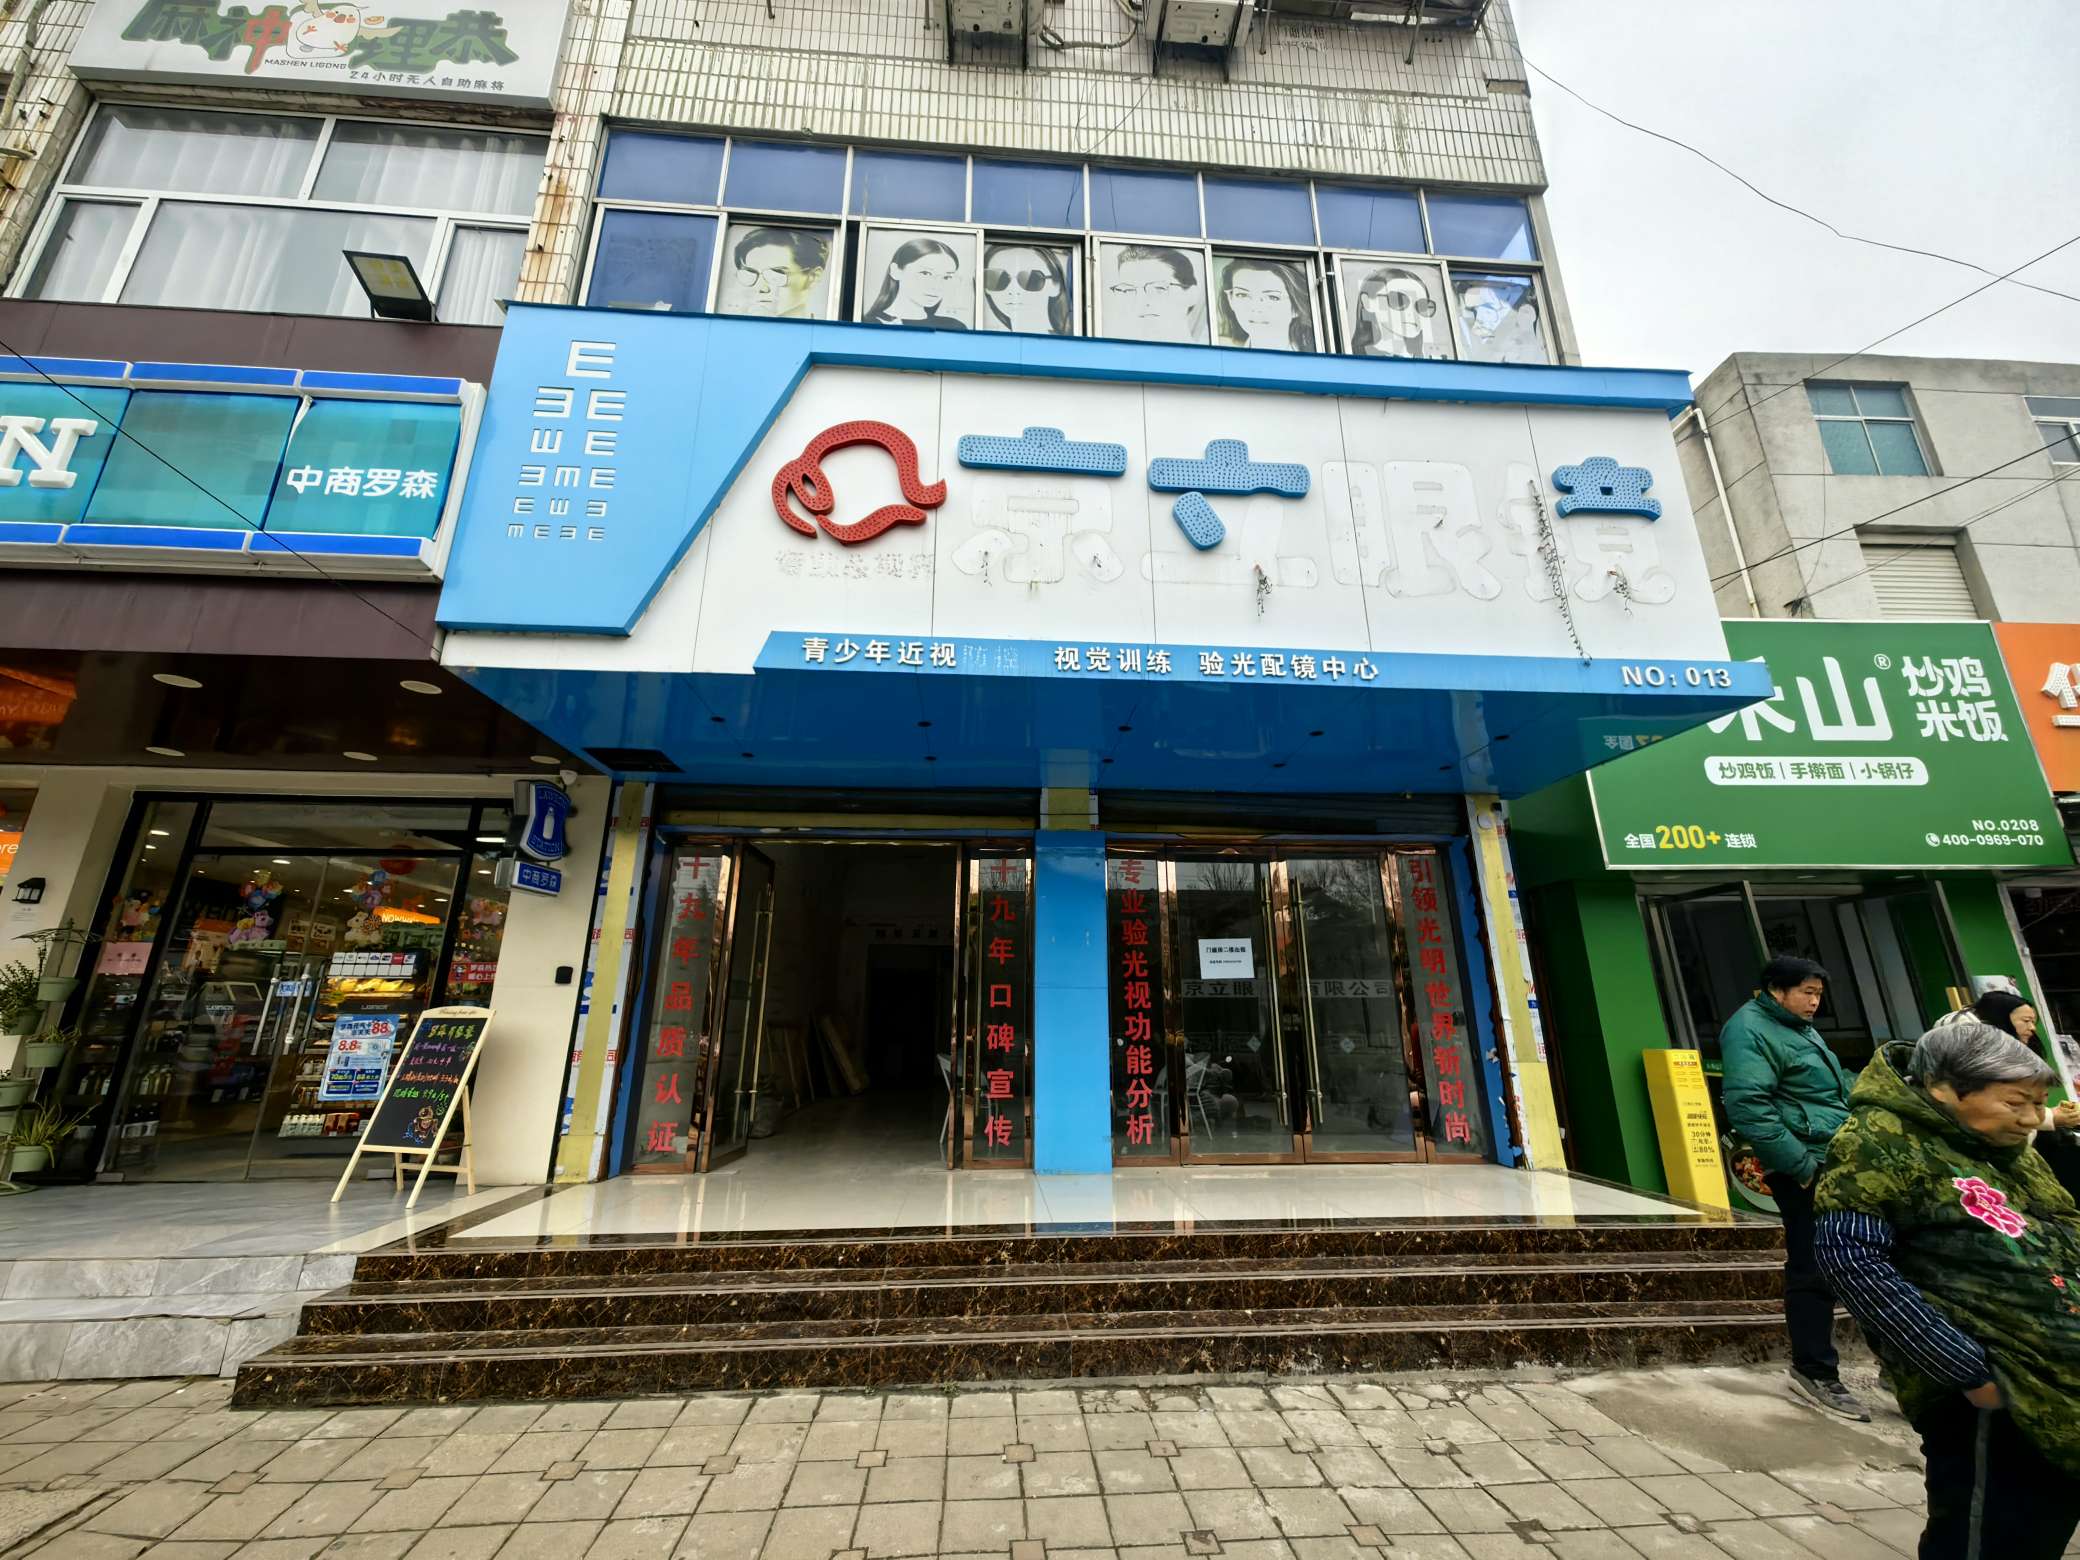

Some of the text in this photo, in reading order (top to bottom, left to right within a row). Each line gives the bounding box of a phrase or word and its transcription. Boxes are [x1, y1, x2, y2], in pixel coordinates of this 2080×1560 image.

[264, 59, 307, 67] MASHEN
[286, 464, 438, 499] 中商罗森
[1054, 646, 1173, 674] 视觉训练
[1199, 650, 1379, 681] 验光配镜中心
[1901, 655, 1992, 699] 炒鸡
[1916, 700, 2009, 743] 米饭
[1942, 833, 2044, 848] 400-0969-070
[1971, 818, 2040, 832] NO.0208
[647, 851, 711, 1154] 十九年品质认证
[983, 855, 1018, 1148] 十九年口碑宣传
[1118, 856, 1154, 1146] 专业验光视功能分析
[1409, 858, 1471, 1144] 引领光明世界新时尚
